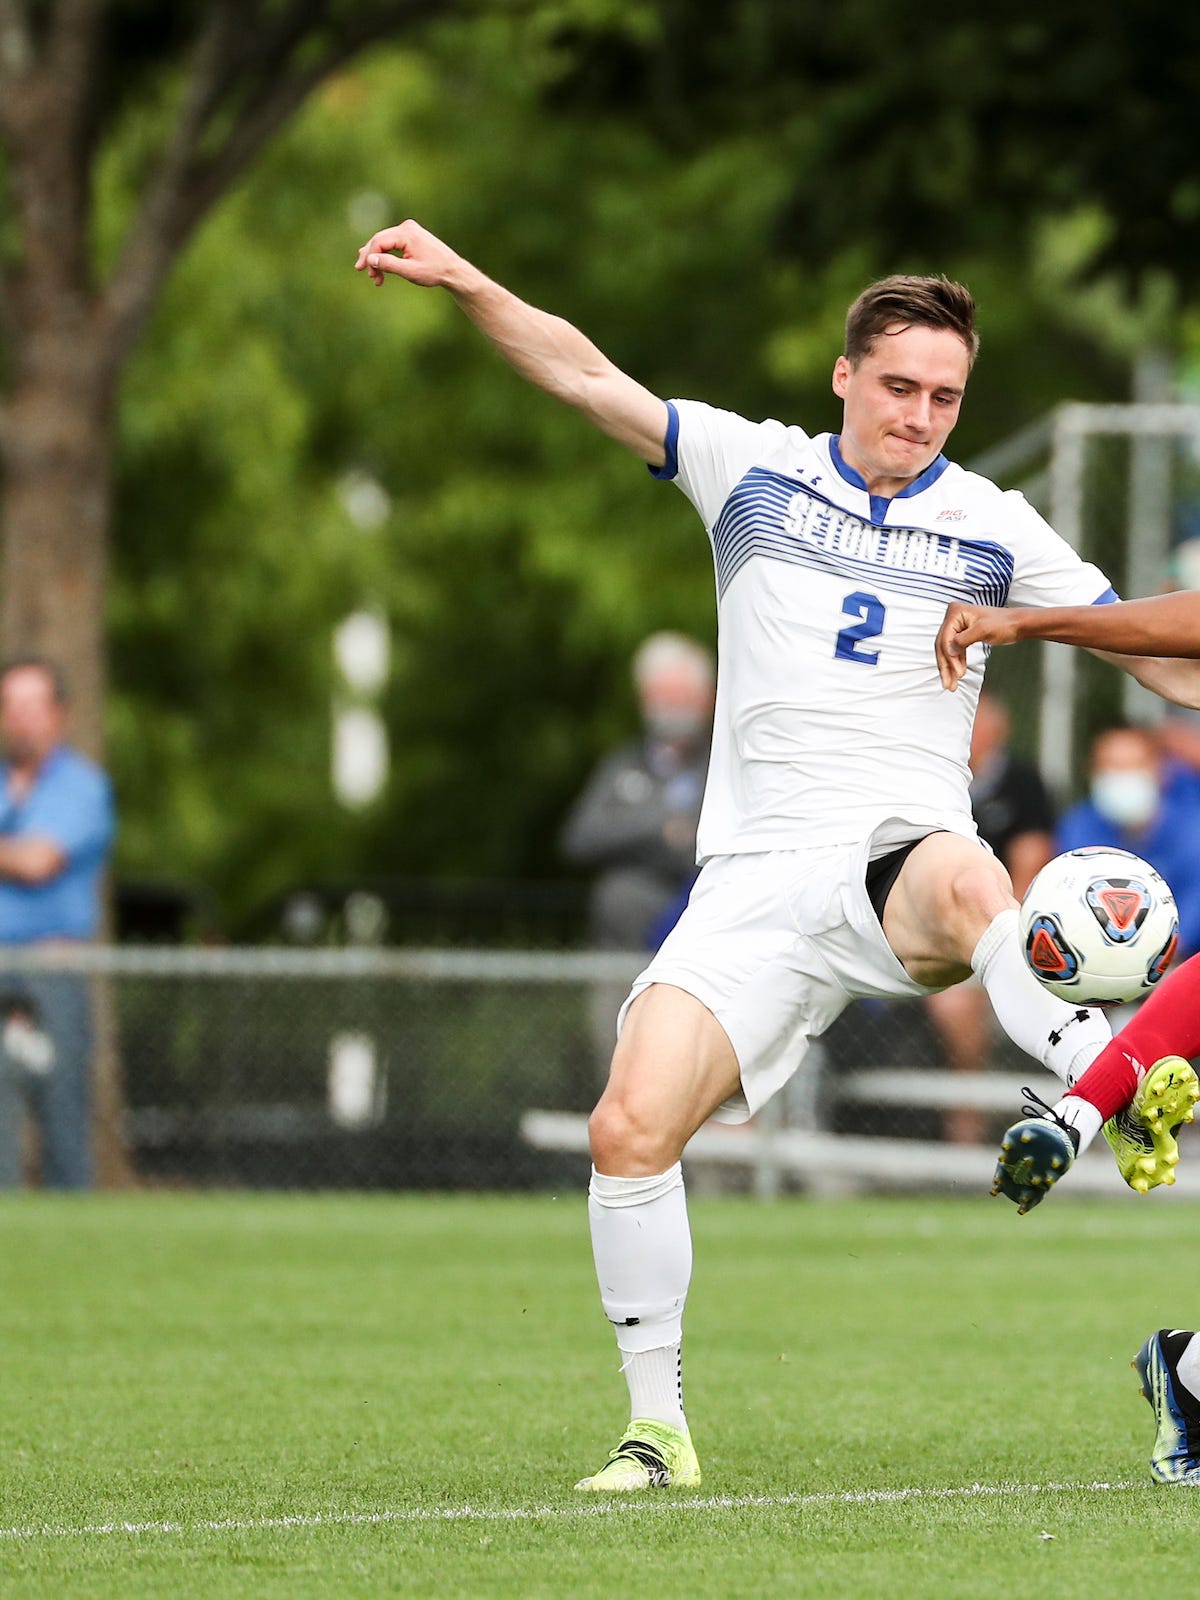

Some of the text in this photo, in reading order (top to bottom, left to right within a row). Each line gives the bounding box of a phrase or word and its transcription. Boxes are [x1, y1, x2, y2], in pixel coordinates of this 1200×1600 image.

[783, 491, 968, 582] SETON HALL
[832, 591, 886, 666] 2
